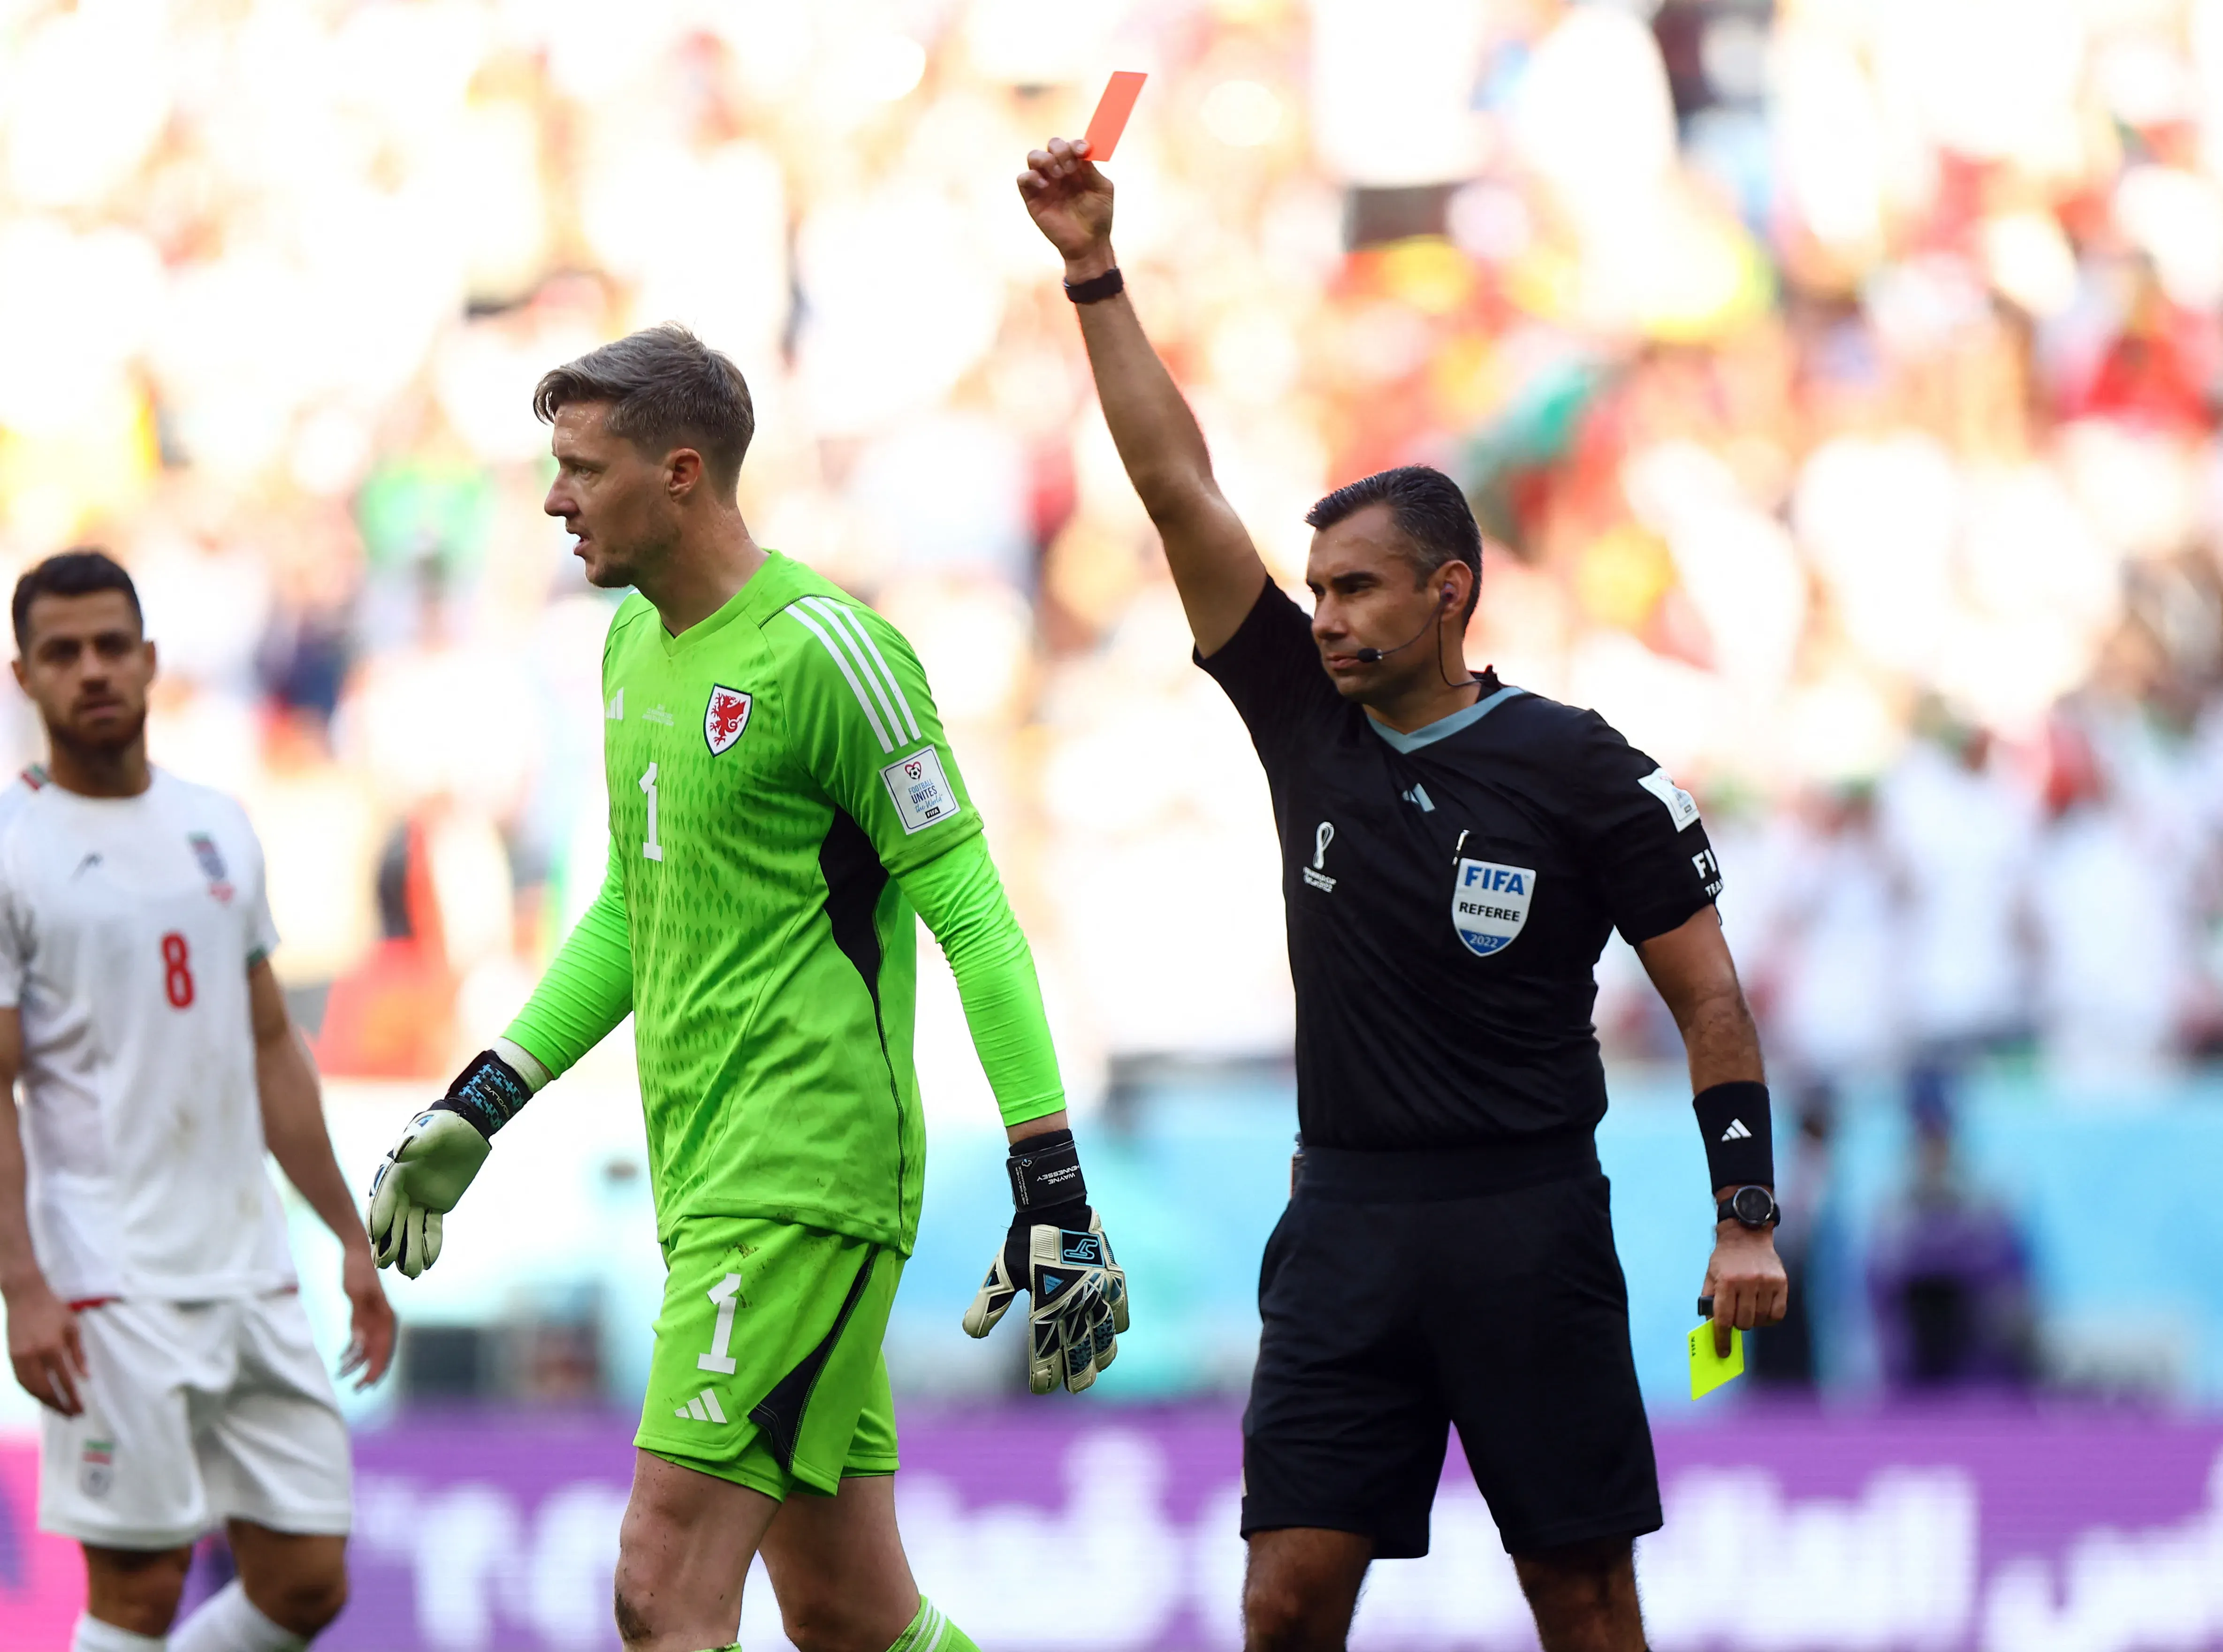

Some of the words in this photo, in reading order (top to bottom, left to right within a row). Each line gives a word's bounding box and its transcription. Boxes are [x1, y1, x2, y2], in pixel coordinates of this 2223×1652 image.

[908, 779, 934, 794] FOOTBALL
[911, 785, 937, 804] UNITES
[639, 761, 662, 861] 1
[915, 804, 926, 813] the
[925, 793, 943, 808] World
[927, 808, 938, 817] FIFA
[1464, 866, 1524, 895] FIFA
[1459, 901, 1521, 922] REFEREE
[1469, 934, 1498, 948] 2022
[160, 930, 194, 1009] 8
[1036, 1165, 1080, 1181] HENNESSEY
[1048, 1172, 1075, 1185] WAYNE
[697, 1272, 742, 1375] 1
